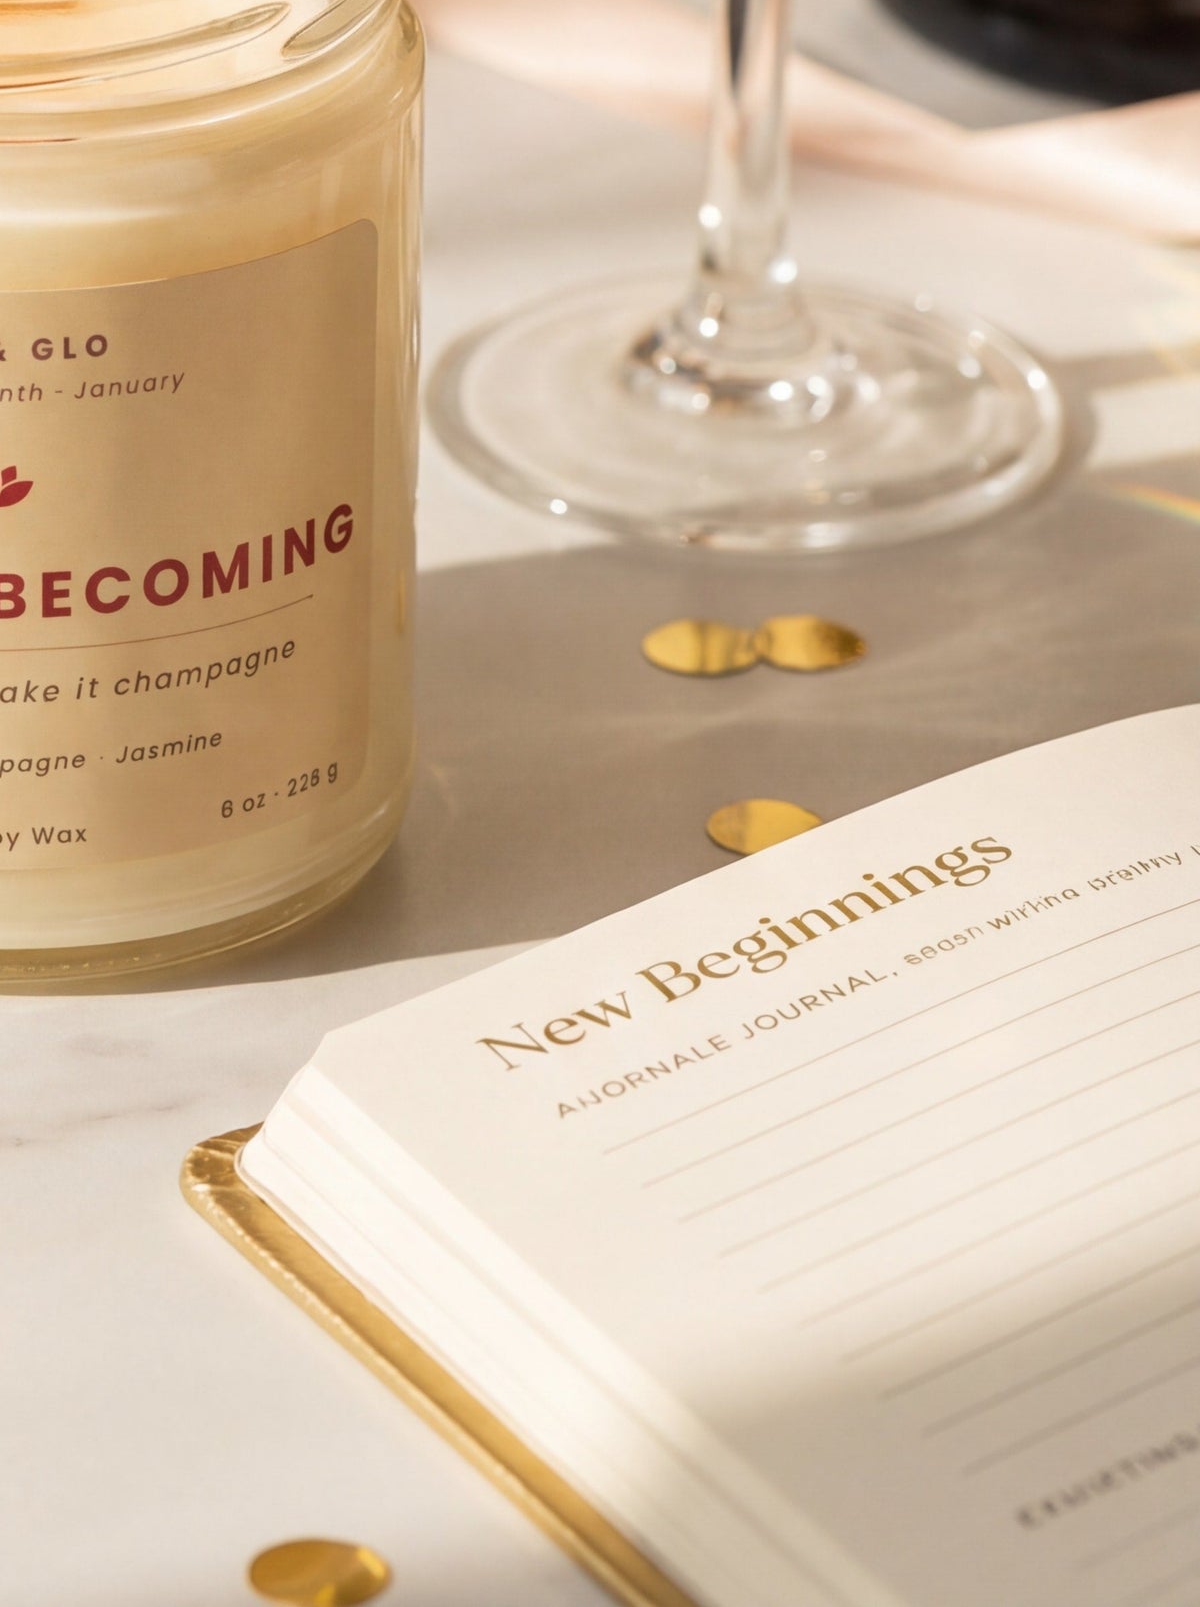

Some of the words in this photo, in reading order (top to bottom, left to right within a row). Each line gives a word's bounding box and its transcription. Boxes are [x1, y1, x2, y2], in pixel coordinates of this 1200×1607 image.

[31, 334, 109, 362] GLO
[73, 372, 185, 400] January
[75, 676, 100, 701] it
[113, 637, 296, 697] champagne
[115, 732, 223, 765] Jasmine
[220, 799, 234, 819] 6
[241, 792, 267, 813] oz
[287, 767, 321, 798] 228
[326, 761, 339, 785] g
[31, 826, 88, 846] Wax
[475, 991, 636, 1071] New
[635, 835, 1013, 1004] Beginnings
